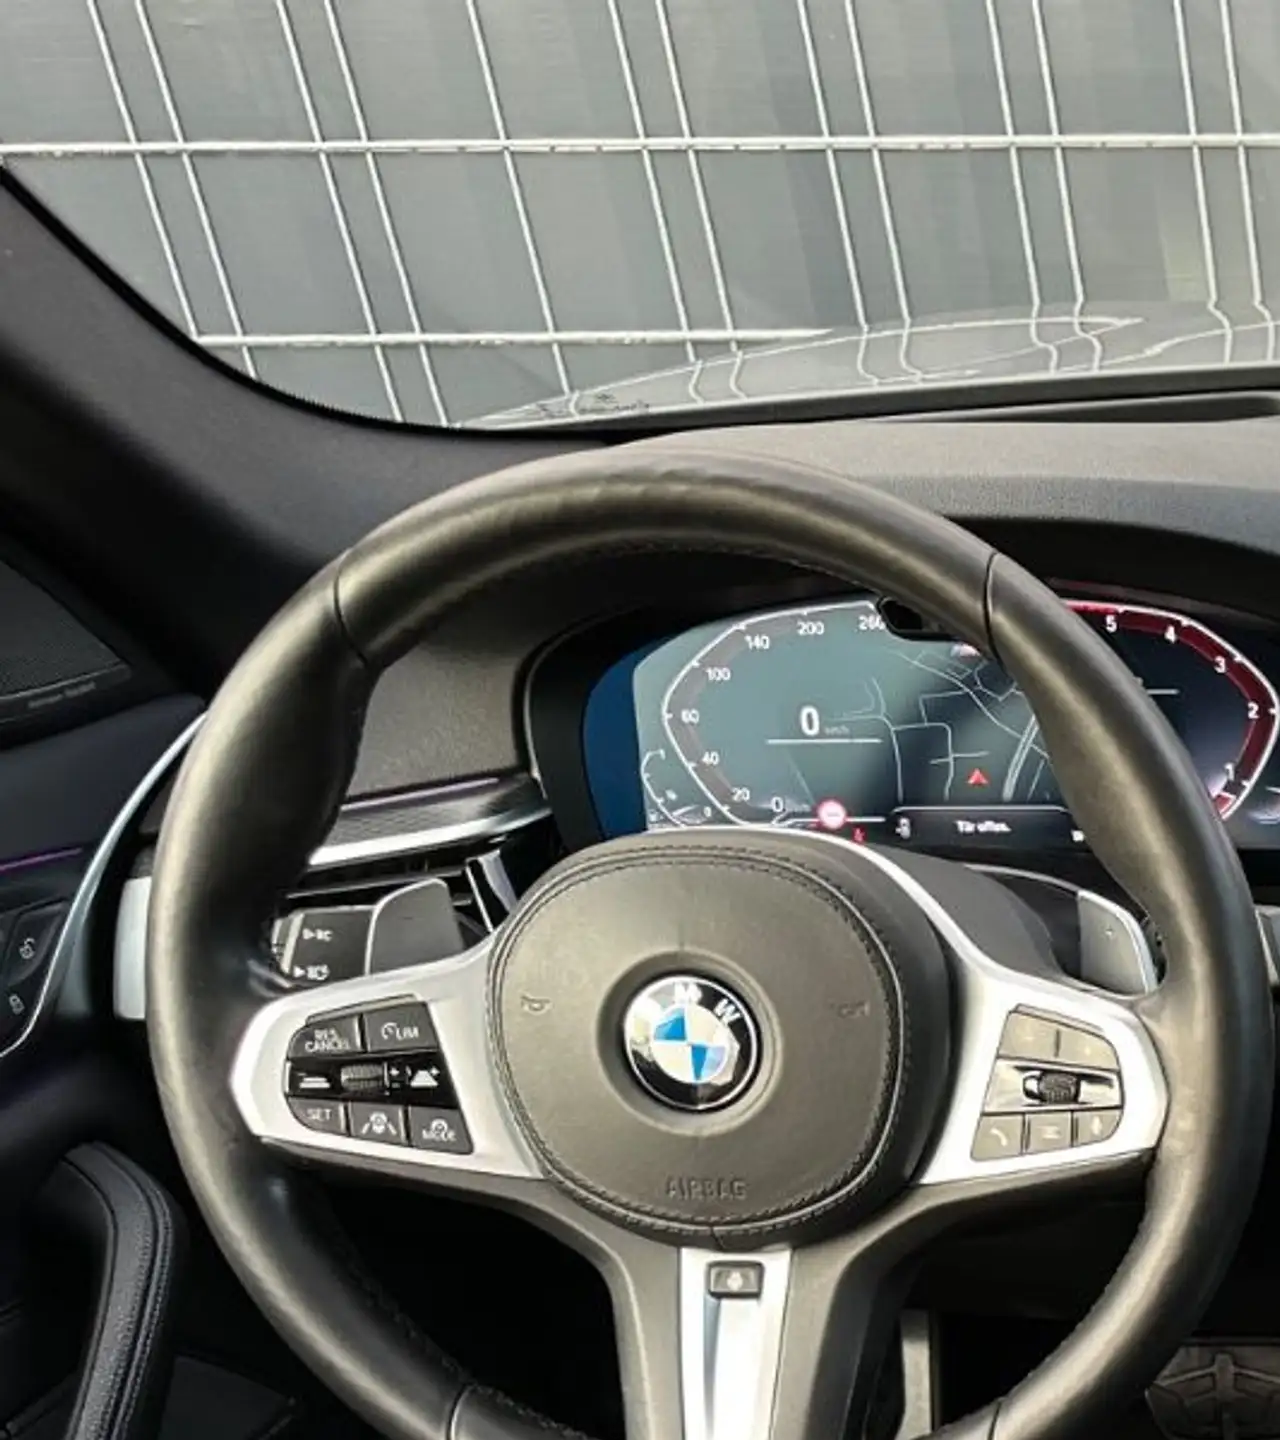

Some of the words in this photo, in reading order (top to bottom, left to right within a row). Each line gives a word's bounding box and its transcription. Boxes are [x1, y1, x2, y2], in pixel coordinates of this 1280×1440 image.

[796, 620, 825, 636] 200
[1105, 615, 1117, 632] 5
[744, 634, 771, 650] 140
[1164, 625, 1176, 643] 4
[1214, 655, 1226, 673] 3
[705, 667, 731, 682] 100
[1247, 701, 1260, 719] 2
[800, 706, 821, 736] 0
[702, 751, 719, 766] 40
[1223, 762, 1235, 780] 1
[731, 787, 750, 802] 20
[771, 796, 784, 812] 0
[307, 1108, 333, 1121] SET
[665, 1177, 748, 1200] AIRBAG
